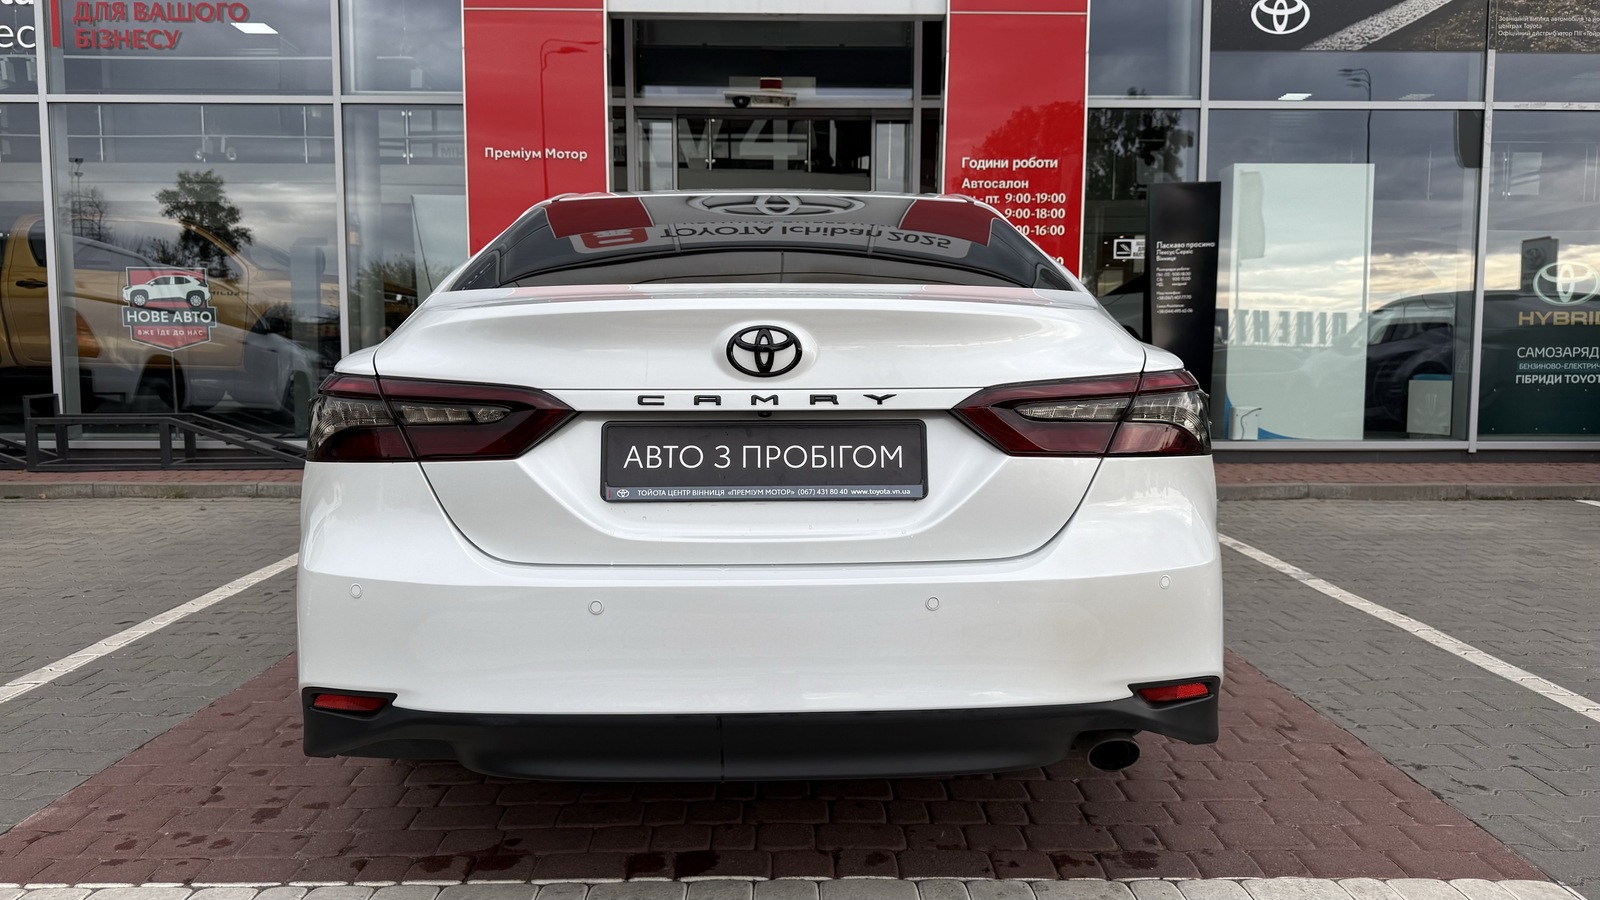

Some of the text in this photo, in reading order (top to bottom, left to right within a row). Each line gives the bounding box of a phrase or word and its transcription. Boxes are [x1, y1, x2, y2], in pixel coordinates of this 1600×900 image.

[73, 1, 248, 25] ДЛЯ ВАШОГО
[75, 28, 180, 49] БІЗНЕСУ
[484, 147, 588, 162] Преміум Мотор
[961, 156, 1058, 171] Години роботи
[962, 178, 1029, 189] Автосалон
[1004, 193, 1066, 204] 9:00-19:00
[1004, 208, 1066, 220] 9:00-18:00
[1156, 241, 1185, 249] Ласкаво
[126, 310, 212, 323] НОВЕ АВТО
[1517, 346, 1600, 360] САМОЗАРЯД
[1516, 374, 1562, 385] ГІБРИДИ
[637, 394, 897, 406] CAMRY
[623, 445, 704, 469] АВТО
[742, 445, 903, 469] ПРОБІГОМ
[638, 488, 910, 497] ТОЙОТА ЦЕНТР ВІННИЦЯ «ПРЕМІУМ МОТОР» (067) 431 80 40 www.toyota.vn.ua
